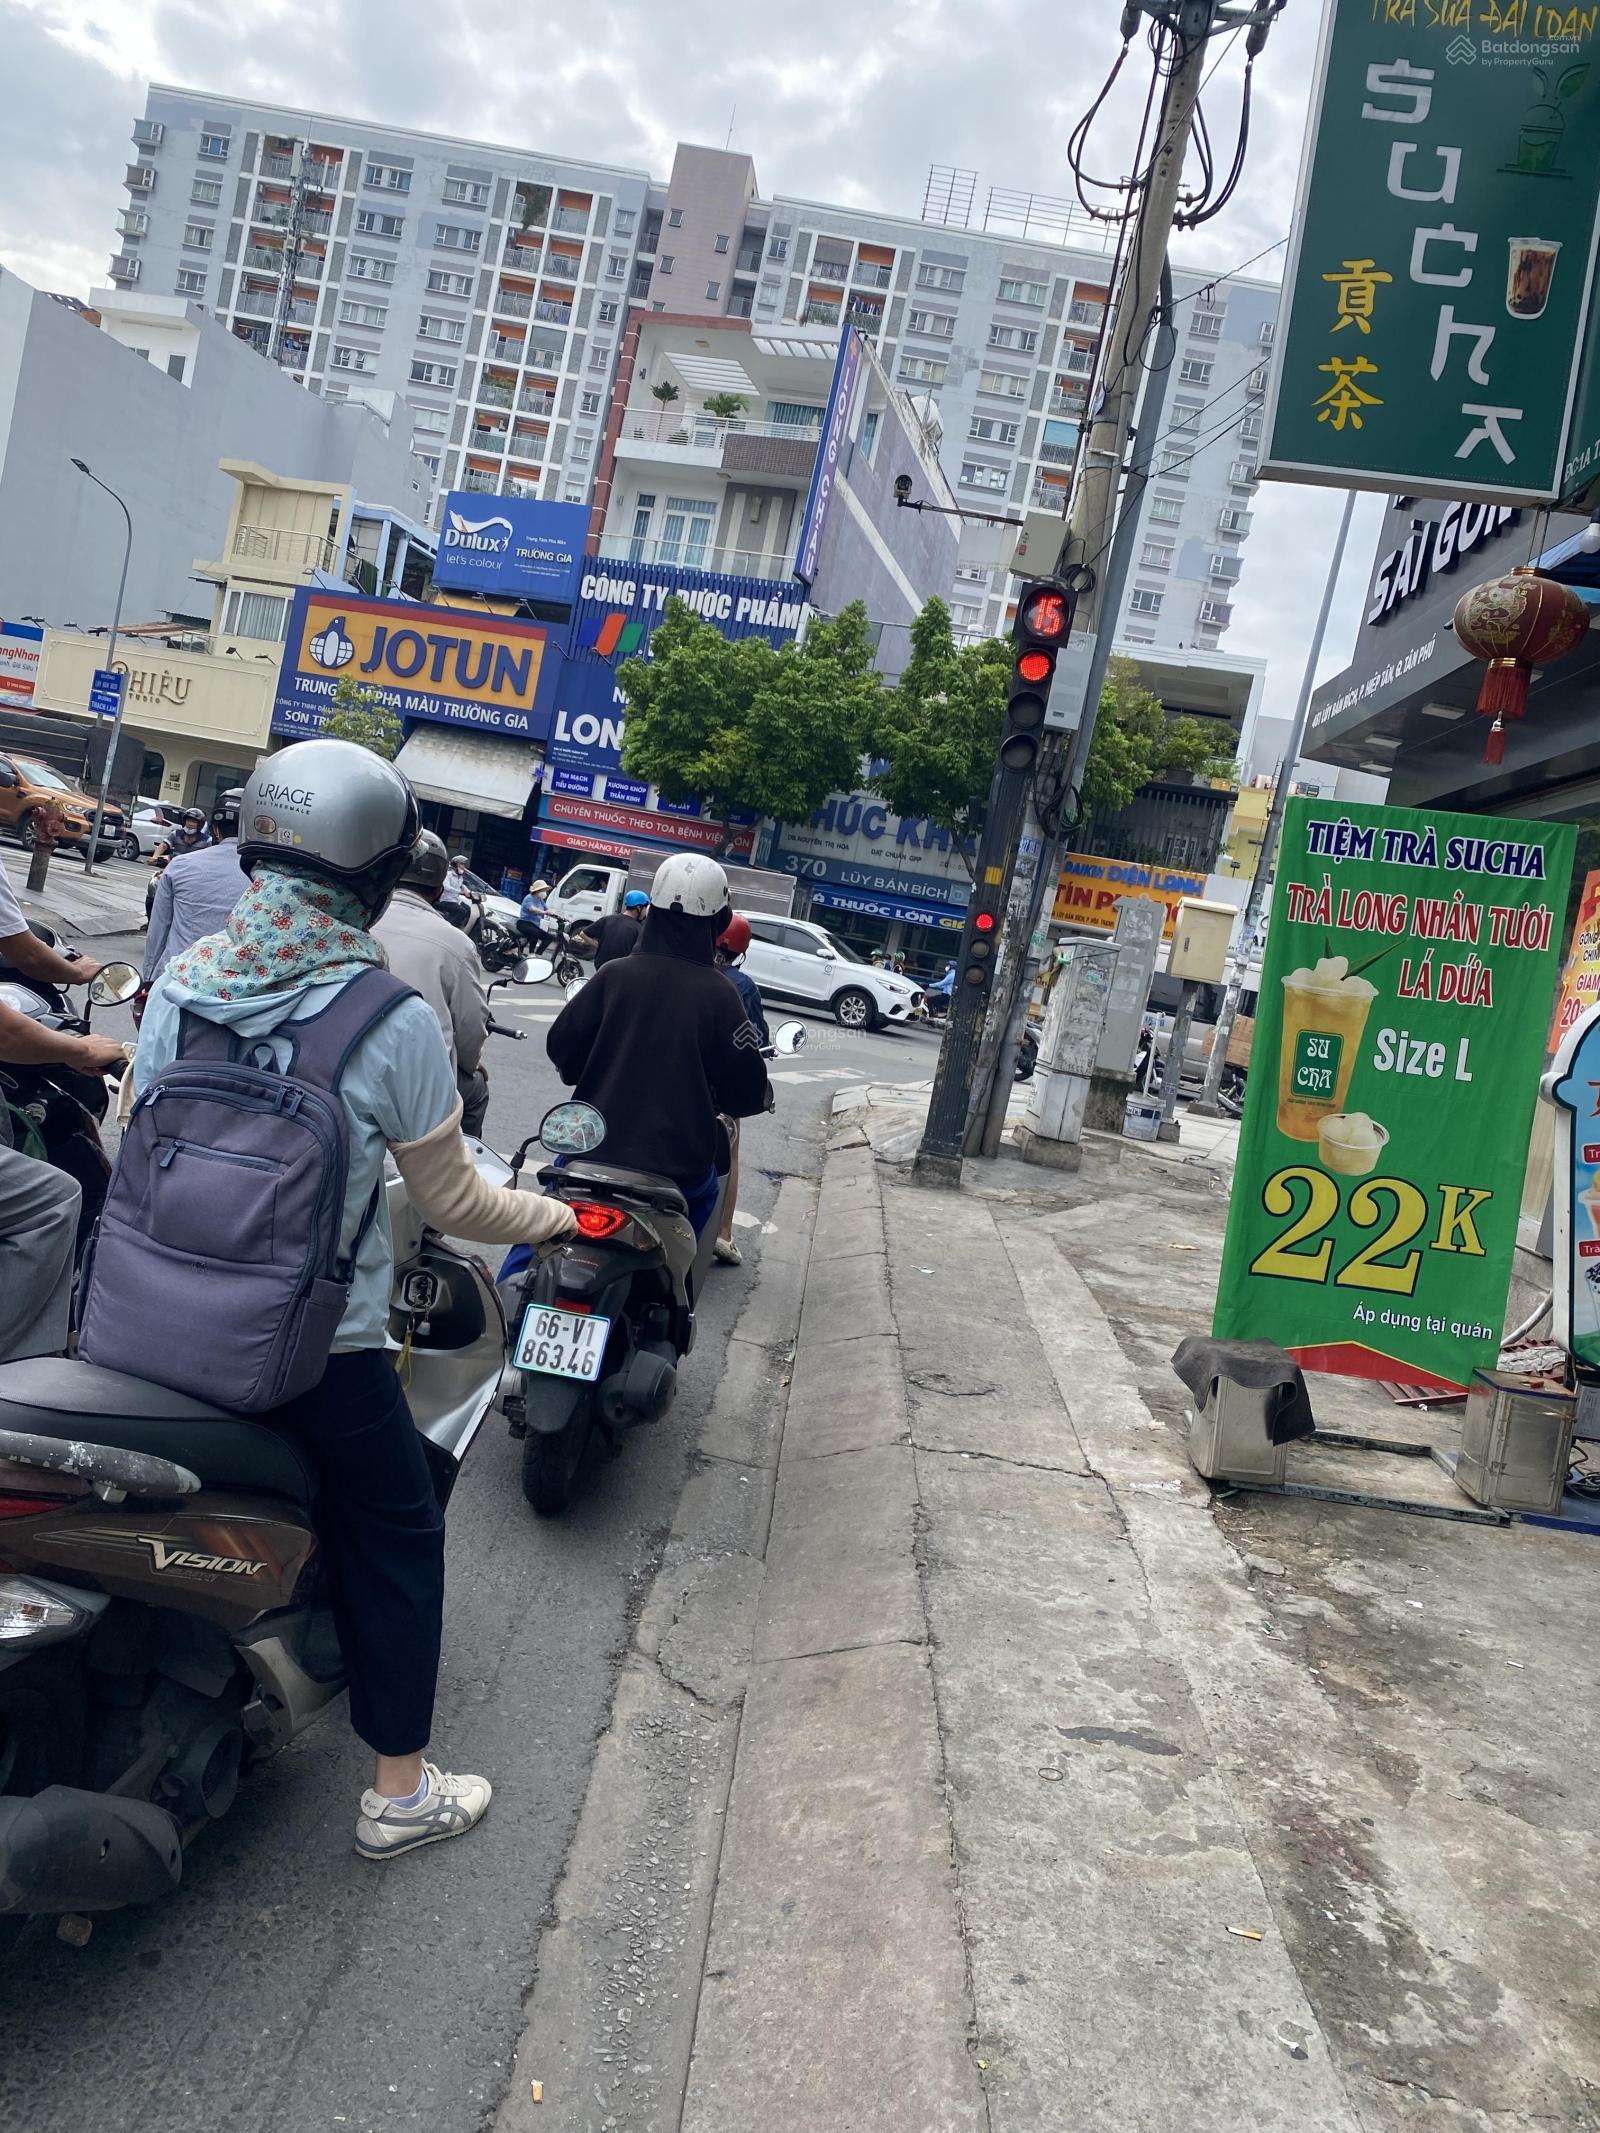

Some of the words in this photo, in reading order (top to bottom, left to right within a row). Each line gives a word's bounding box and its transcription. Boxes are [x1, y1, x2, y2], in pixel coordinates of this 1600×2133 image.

[1534, 5, 1598, 42] LOAN
[828, 366, 850, 463] LONG
[444, 528, 500, 553] Dulux
[805, 474, 830, 577] CHÂU
[446, 553, 467, 566] let's
[470, 558, 502, 571] colour
[556, 553, 573, 563] GIA
[580, 572, 636, 606] CÔNG
[643, 584, 669, 611] TY
[736, 591, 800, 630] PHẨM
[360, 625, 533, 696] JOTUN
[128, 692, 161, 704] TUDIO
[294, 677, 338, 697] TRUNG
[377, 690, 401, 708] PHA
[405, 692, 439, 714] MÀU
[443, 700, 500, 726] TRƯỜNG
[504, 712, 528, 730] GIA
[285, 709, 309, 724] SƠN
[554, 710, 626, 751] LON
[258, 783, 315, 807] URIAGE
[554, 803, 591, 818] CHUYÊN
[593, 810, 626, 825] THUỐC
[629, 818, 653, 830] THEO
[656, 823, 675, 834] TOA
[677, 825, 703, 839] BỆNH
[810, 795, 887, 840] HÚC
[566, 836, 587, 848] GIAO
[588, 838, 612, 852] HÀNG
[1306, 817, 1379, 864] TIỆM
[1381, 825, 1440, 868] TRÀ
[1444, 836, 1547, 880] SUCHA
[785, 855, 827, 877] 370
[1107, 865, 1151, 888] ĐIỆN
[840, 871, 872, 885] LŨY
[874, 877, 908, 892] BÁN
[911, 882, 948, 900] BÍCH
[1055, 882, 1093, 908] TÍN
[831, 896, 891, 916] THUỐC
[894, 909, 933, 924] LỚN
[1286, 872, 1333, 926] TRÀ
[1336, 888, 1408, 935] LONG
[1488, 902, 1555, 952] TƯƠI
[1397, 948, 1435, 1000] LÁ
[1437, 952, 1494, 1008] DỨA
[1306, 1038, 1331, 1059] SU
[1373, 1028, 1446, 1079] Size
[1455, 1037, 1473, 1082] L
[535, 1311, 596, 1347] 66-V1
[1353, 1301, 1376, 1323] Áp
[1380, 1309, 1421, 1332] dụng
[1426, 1315, 1446, 1333] tại
[1450, 1322, 1493, 1341] quán
[522, 1339, 596, 1376] 863.46
